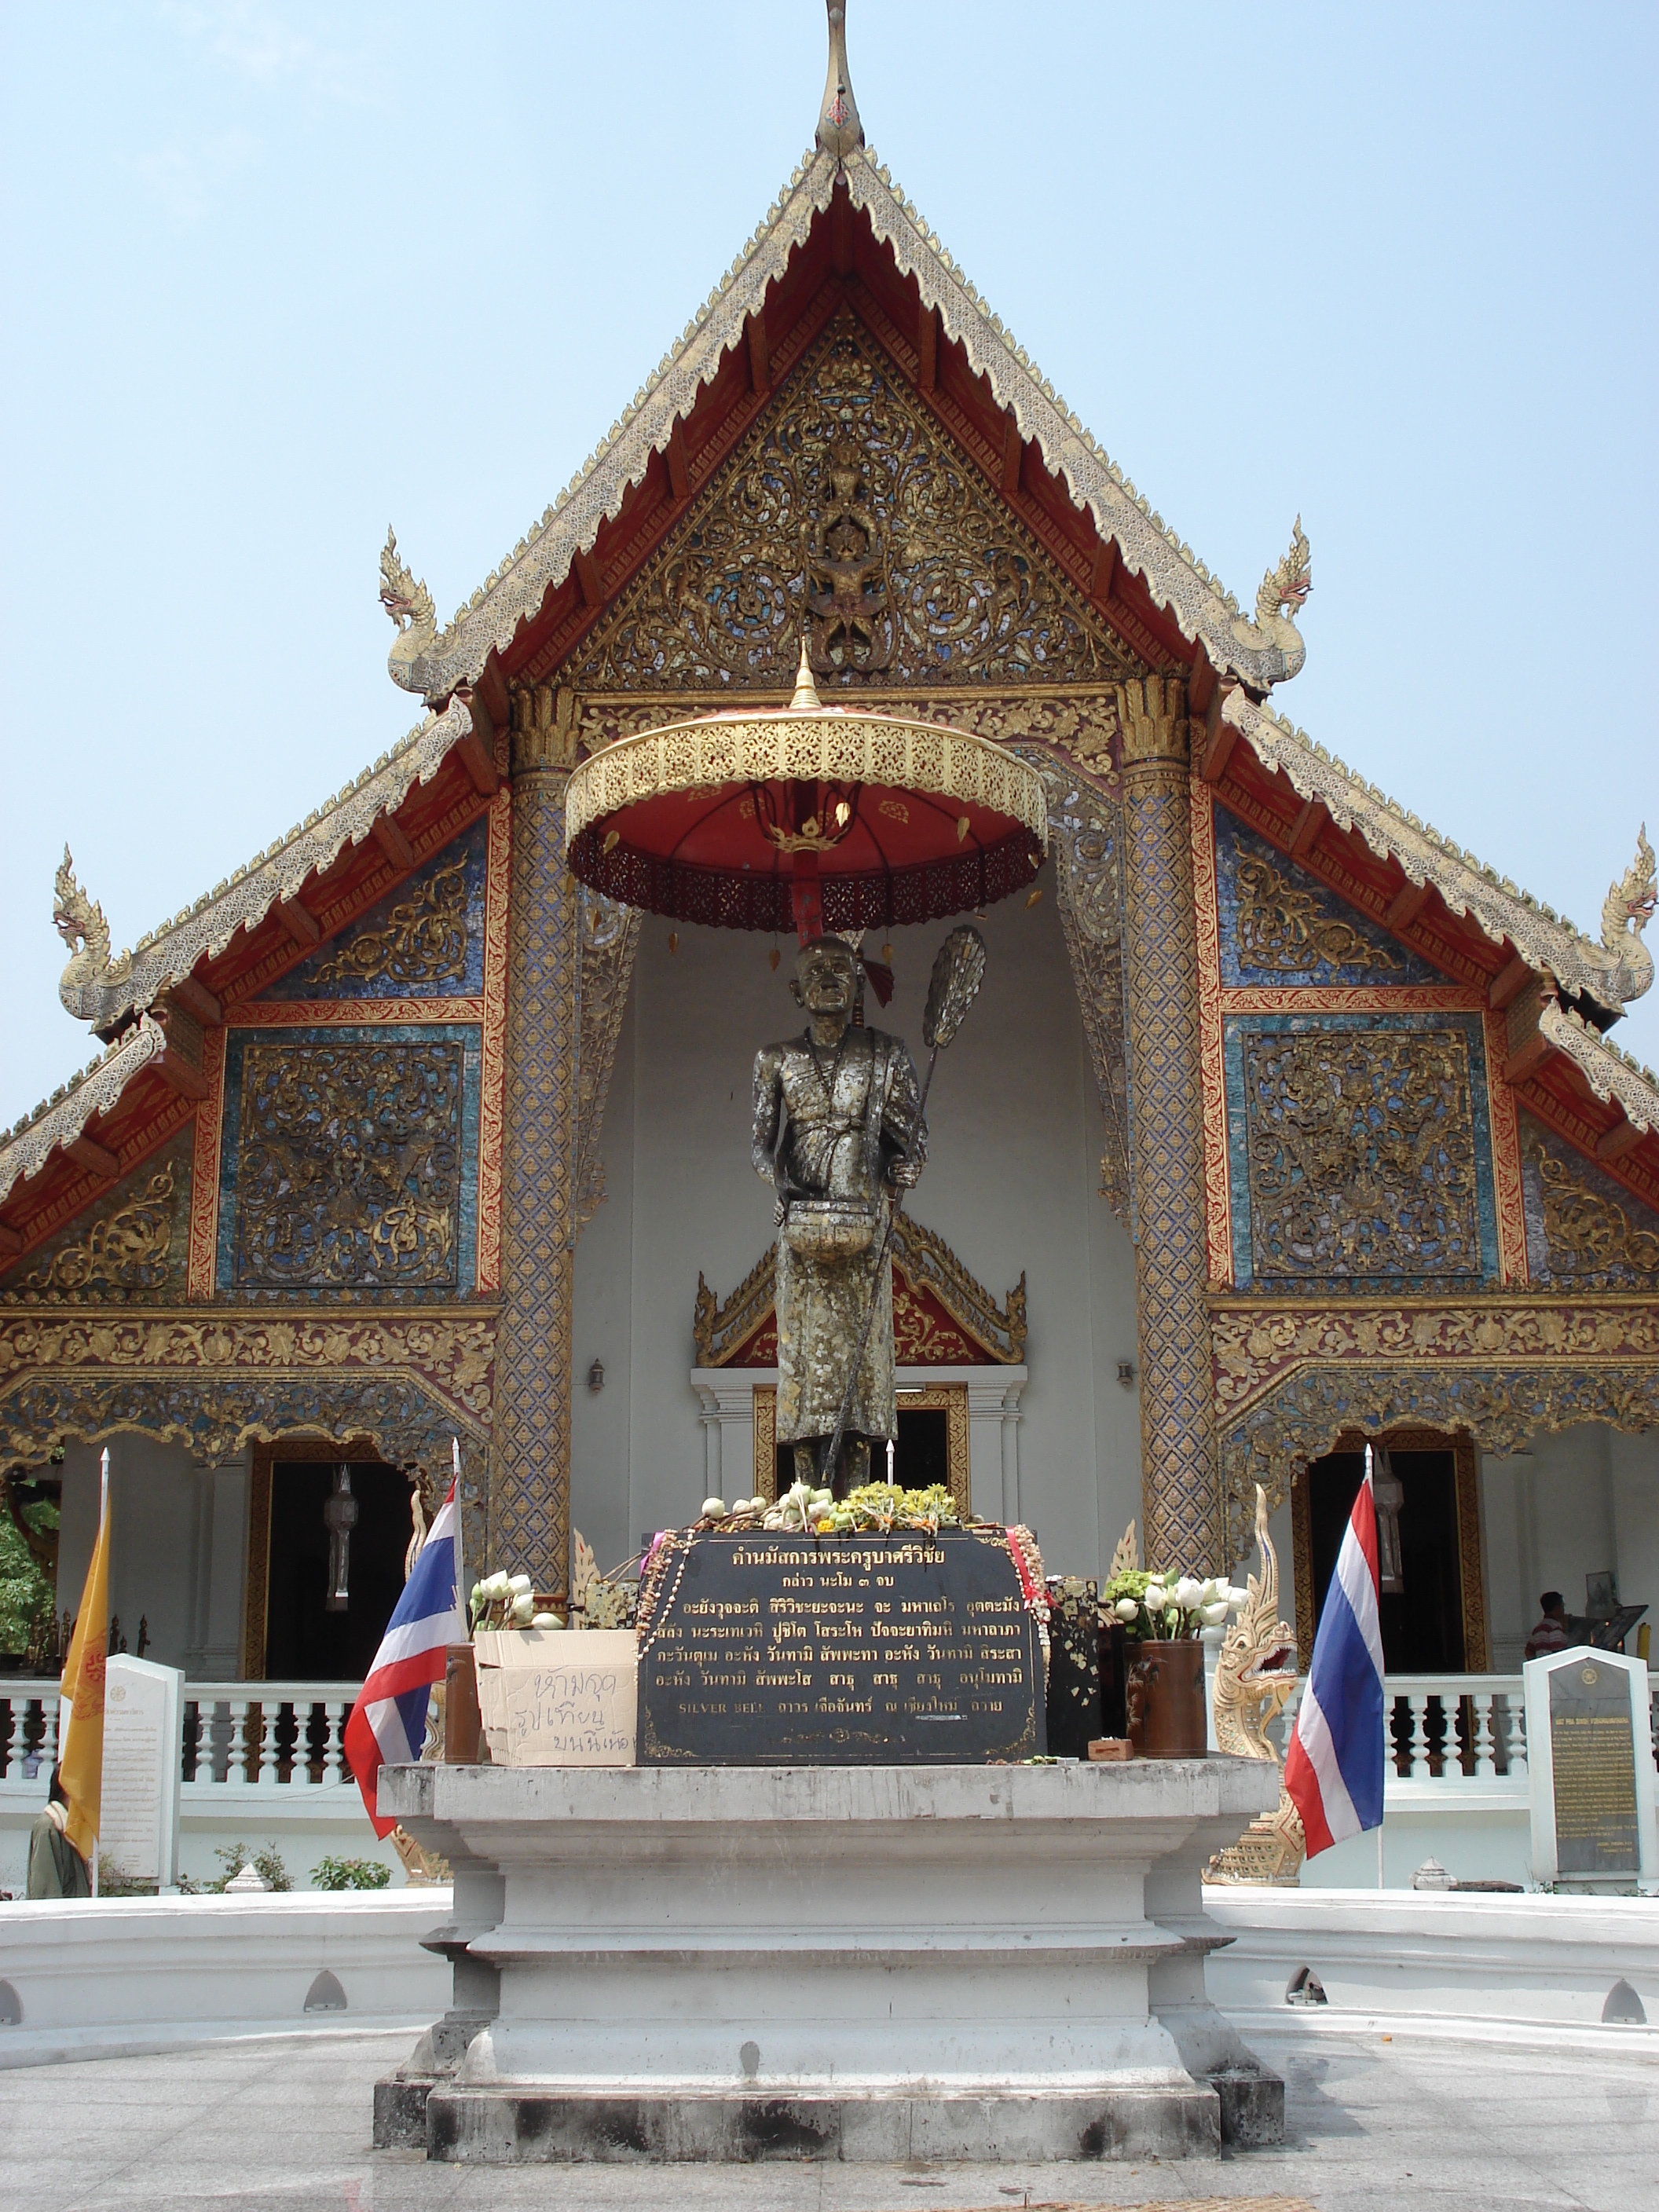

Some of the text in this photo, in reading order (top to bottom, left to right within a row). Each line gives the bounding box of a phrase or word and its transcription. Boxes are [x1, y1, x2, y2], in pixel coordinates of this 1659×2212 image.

[732, 1545, 945, 1571] คำนมัสการพระครูบาศรีวิชัย
[783, 1570, 893, 1587] กล่าว นะโม ๓ จบ
[874, 1602, 891, 1613] จะ
[884, 1644, 919, 1662] อะหัง
[533, 1665, 617, 1702] ห้ามจุด
[830, 1675, 854, 1691] สาธุ
[873, 1674, 897, 1690] สาธุ
[917, 1674, 940, 1690] สาธุ
[679, 1703, 727, 1713] SILVER
